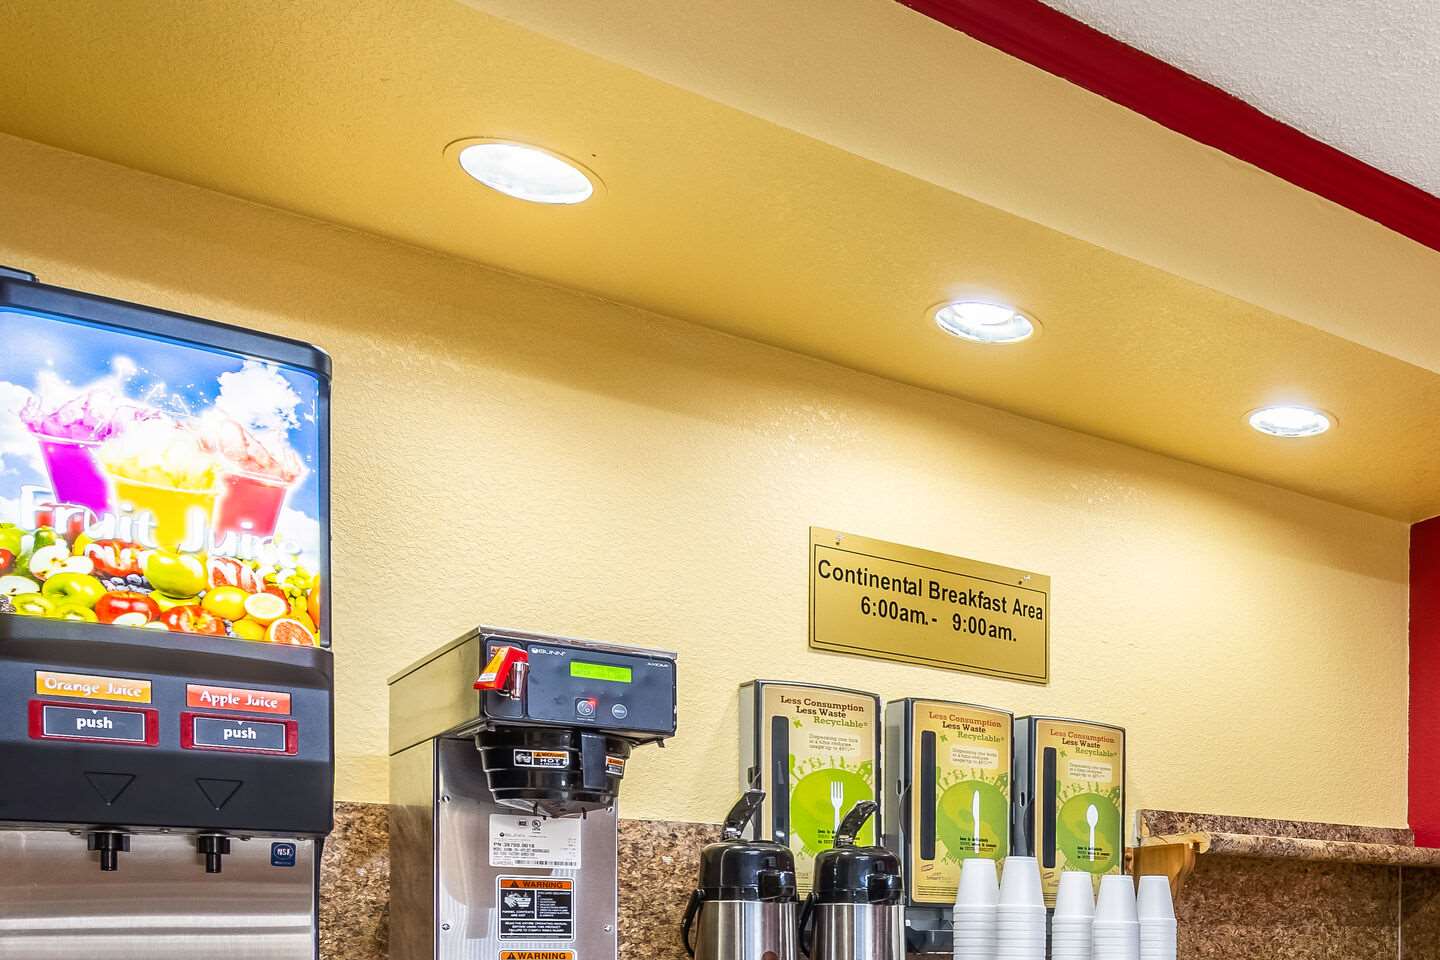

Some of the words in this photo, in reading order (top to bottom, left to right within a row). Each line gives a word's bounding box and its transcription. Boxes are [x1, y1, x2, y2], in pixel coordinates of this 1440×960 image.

[818, 559, 922, 597] Continental
[929, 580, 1008, 614] Breakfast
[1012, 598, 1043, 621] Area
[952, 612, 1017, 643] 9:00am.
[44, 677, 101, 695] Orange
[105, 683, 142, 698] Juice
[199, 690, 241, 706] Apple
[244, 695, 279, 709] Juice
[780, 695, 802, 705] Less
[803, 698, 865, 713] Consumption
[796, 706, 817, 715] Less
[819, 708, 847, 718] Waste
[928, 711, 948, 720] Less
[949, 714, 1002, 728] Consumption
[76, 715, 113, 730] push
[942, 721, 961, 730] Less
[962, 723, 987, 733] Waste
[223, 727, 257, 740] push
[1049, 728, 1067, 738] Less
[1067, 731, 1116, 744] Consumption
[1062, 738, 1079, 746] Less
[1079, 740, 1101, 749] Waste
[522, 881, 564, 889] WARNING
[517, 952, 566, 960] WARNING
